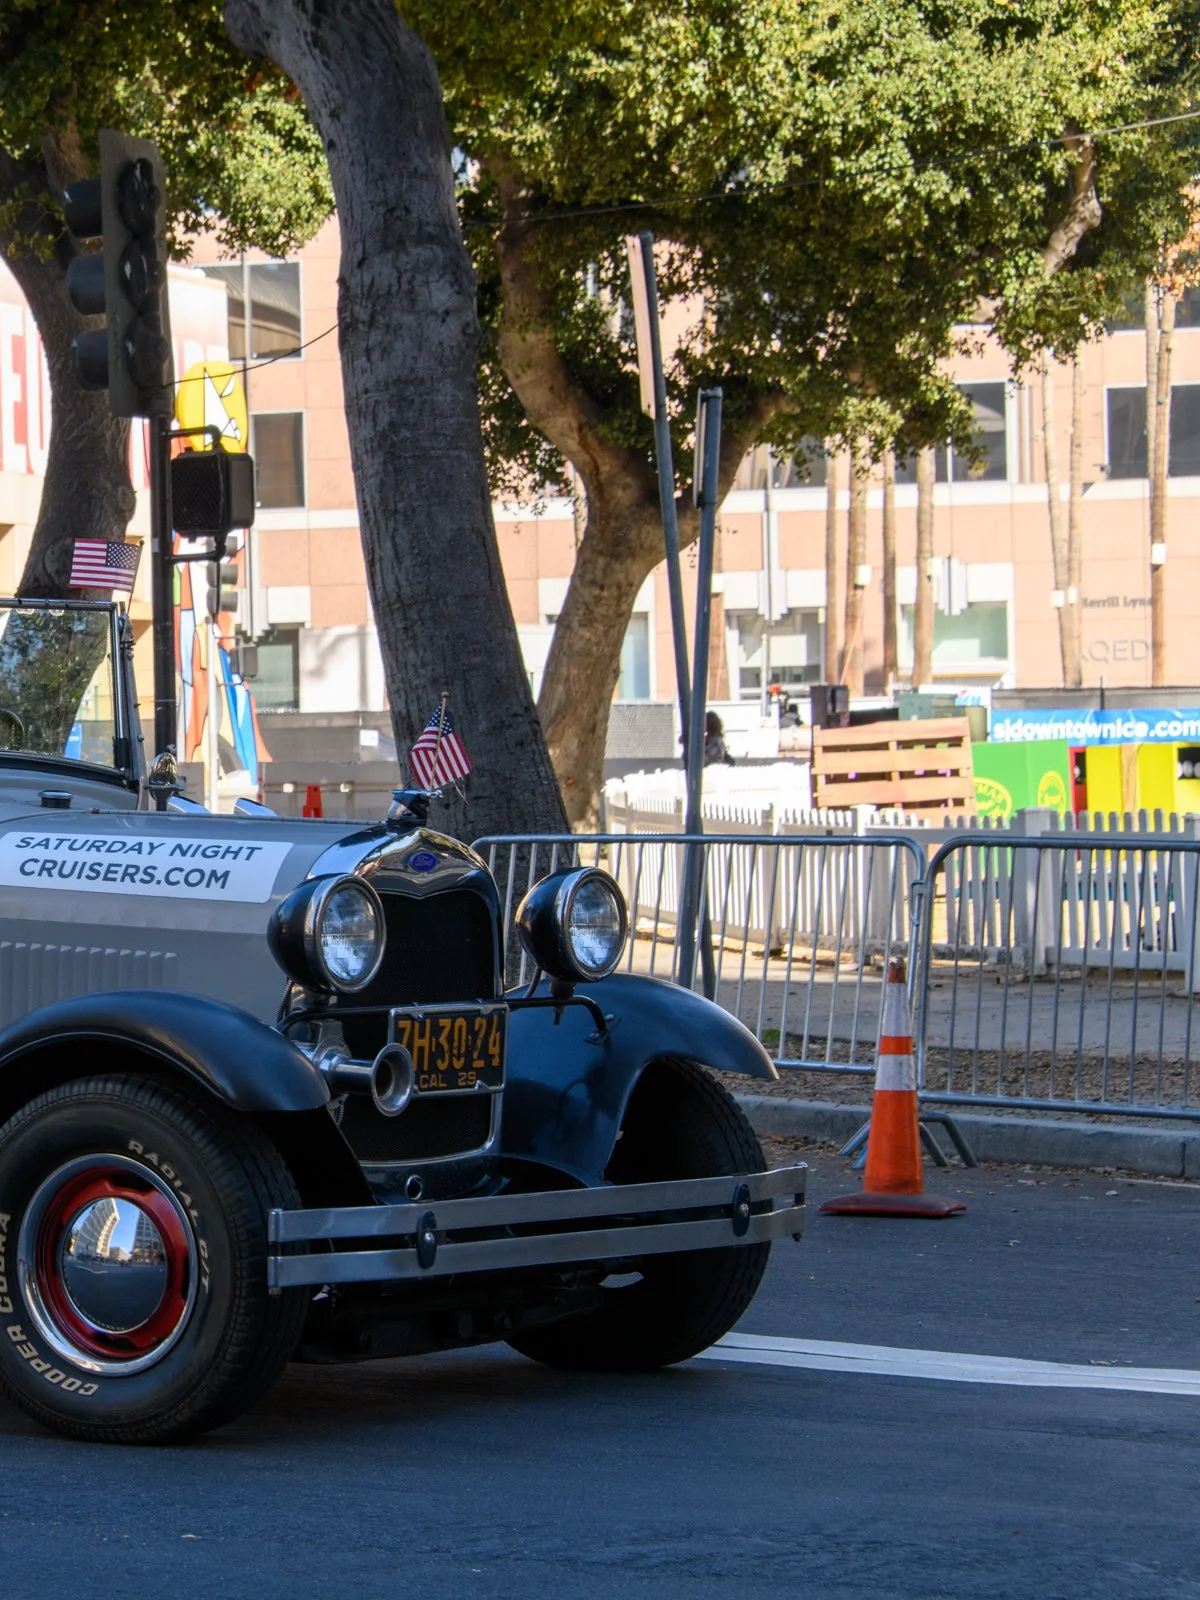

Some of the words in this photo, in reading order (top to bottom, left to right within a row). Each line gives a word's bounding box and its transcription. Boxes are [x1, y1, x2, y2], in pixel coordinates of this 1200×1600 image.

[1082, 639, 1150, 663] QED
[15, 836, 165, 855] SATURDAY
[169, 842, 264, 861] NIGHT
[19, 858, 231, 890] CRUISERS.COM
[419, 1073, 447, 1089] CAL
[127, 1139, 200, 1228] RADIAL
[7, 1324, 100, 1397] COOPER
